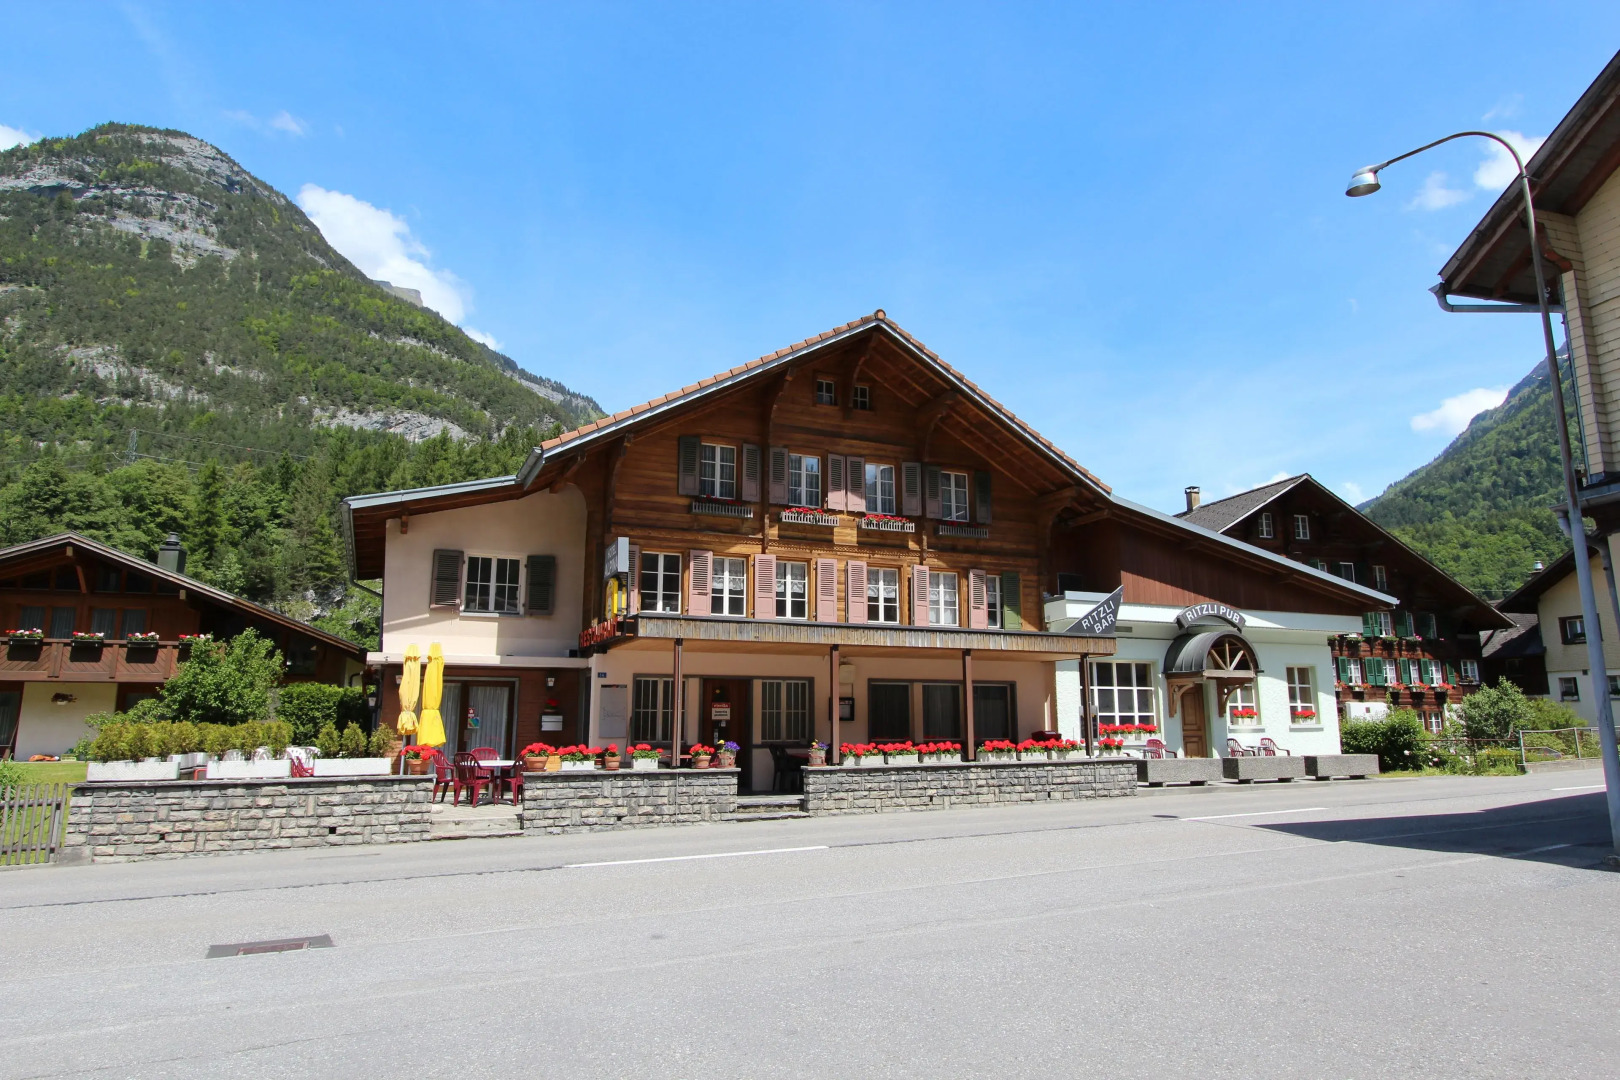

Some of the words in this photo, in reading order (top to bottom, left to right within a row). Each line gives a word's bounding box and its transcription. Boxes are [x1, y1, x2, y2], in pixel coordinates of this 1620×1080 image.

[1081, 600, 1115, 630] RITZLI
[1093, 613, 1115, 634] BAR
[1185, 604, 1217, 622] RITZLI
[1219, 605, 1240, 623] PUB
